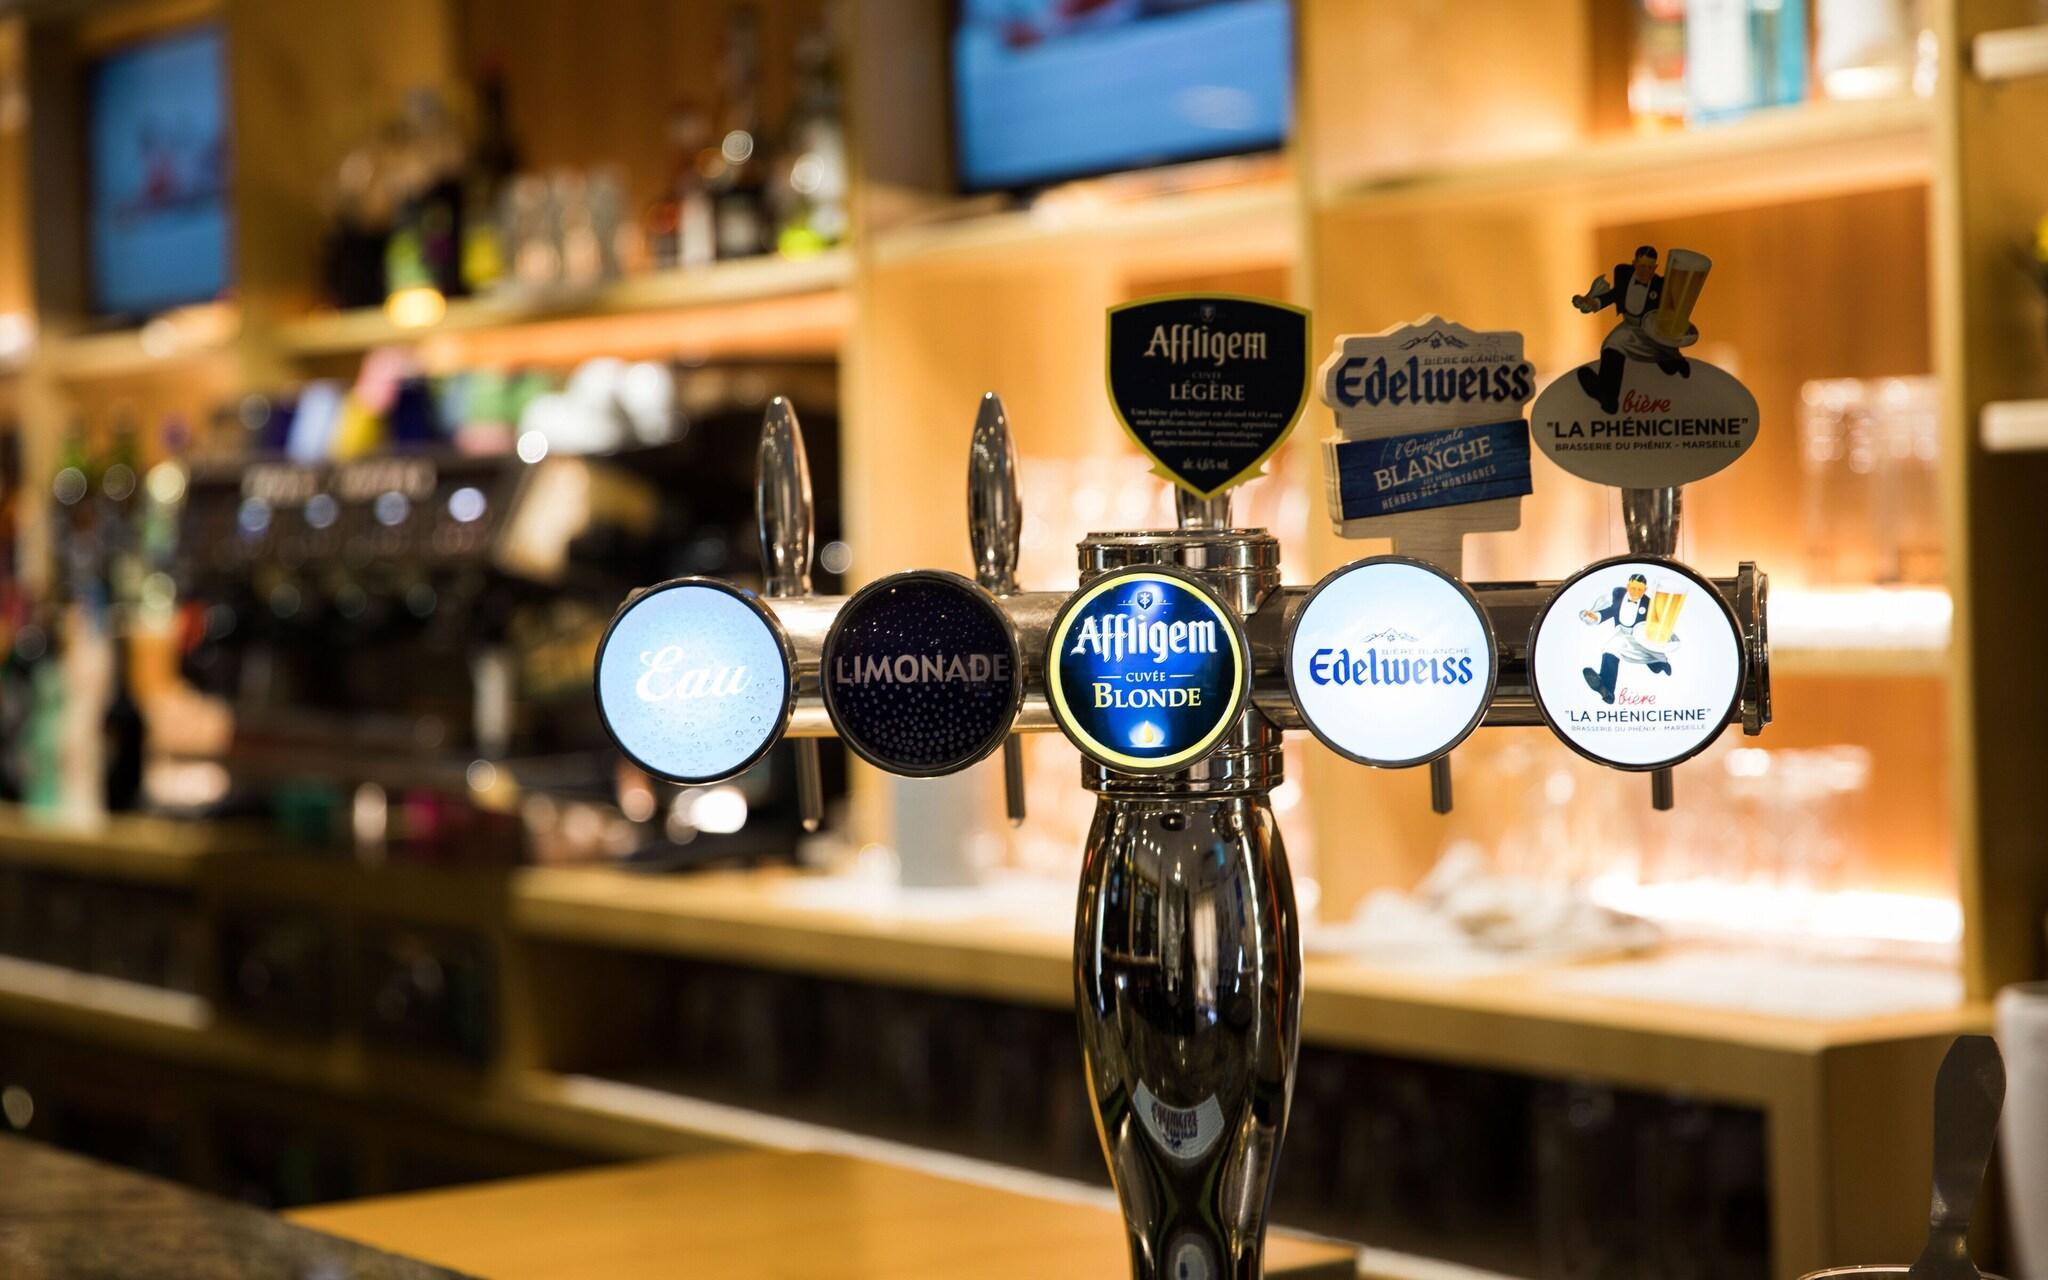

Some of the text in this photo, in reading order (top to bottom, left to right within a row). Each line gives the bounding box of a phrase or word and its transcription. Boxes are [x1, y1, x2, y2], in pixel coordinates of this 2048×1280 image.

[1144, 324, 1267, 366] Affligem
[1170, 379, 1245, 400] LÉGÈRE
[1336, 356, 1532, 408] Edelweiss
[1622, 389, 1671, 414] bière
[1547, 416, 1749, 438] "LA PHÉNICIENNE"
[1555, 442, 1612, 452] BRASSERIE
[1616, 441, 1631, 450] DU
[1634, 438, 1672, 450] PHÉNIX
[1682, 440, 1741, 450] MARSEILLE
[1374, 435, 1493, 492] BLANCHE
[1381, 491, 1418, 510] HERBES
[1421, 483, 1439, 497] DES
[1441, 464, 1497, 489] MONTAGNES
[1070, 614, 1218, 664] Affligem
[636, 645, 753, 702] Eau
[836, 654, 1009, 684] LIMONADE
[1125, 670, 1166, 682] CUVÉE
[1309, 648, 1473, 686] Edelweiss
[1092, 682, 1202, 709] BLONDE
[1618, 687, 1656, 706] bière
